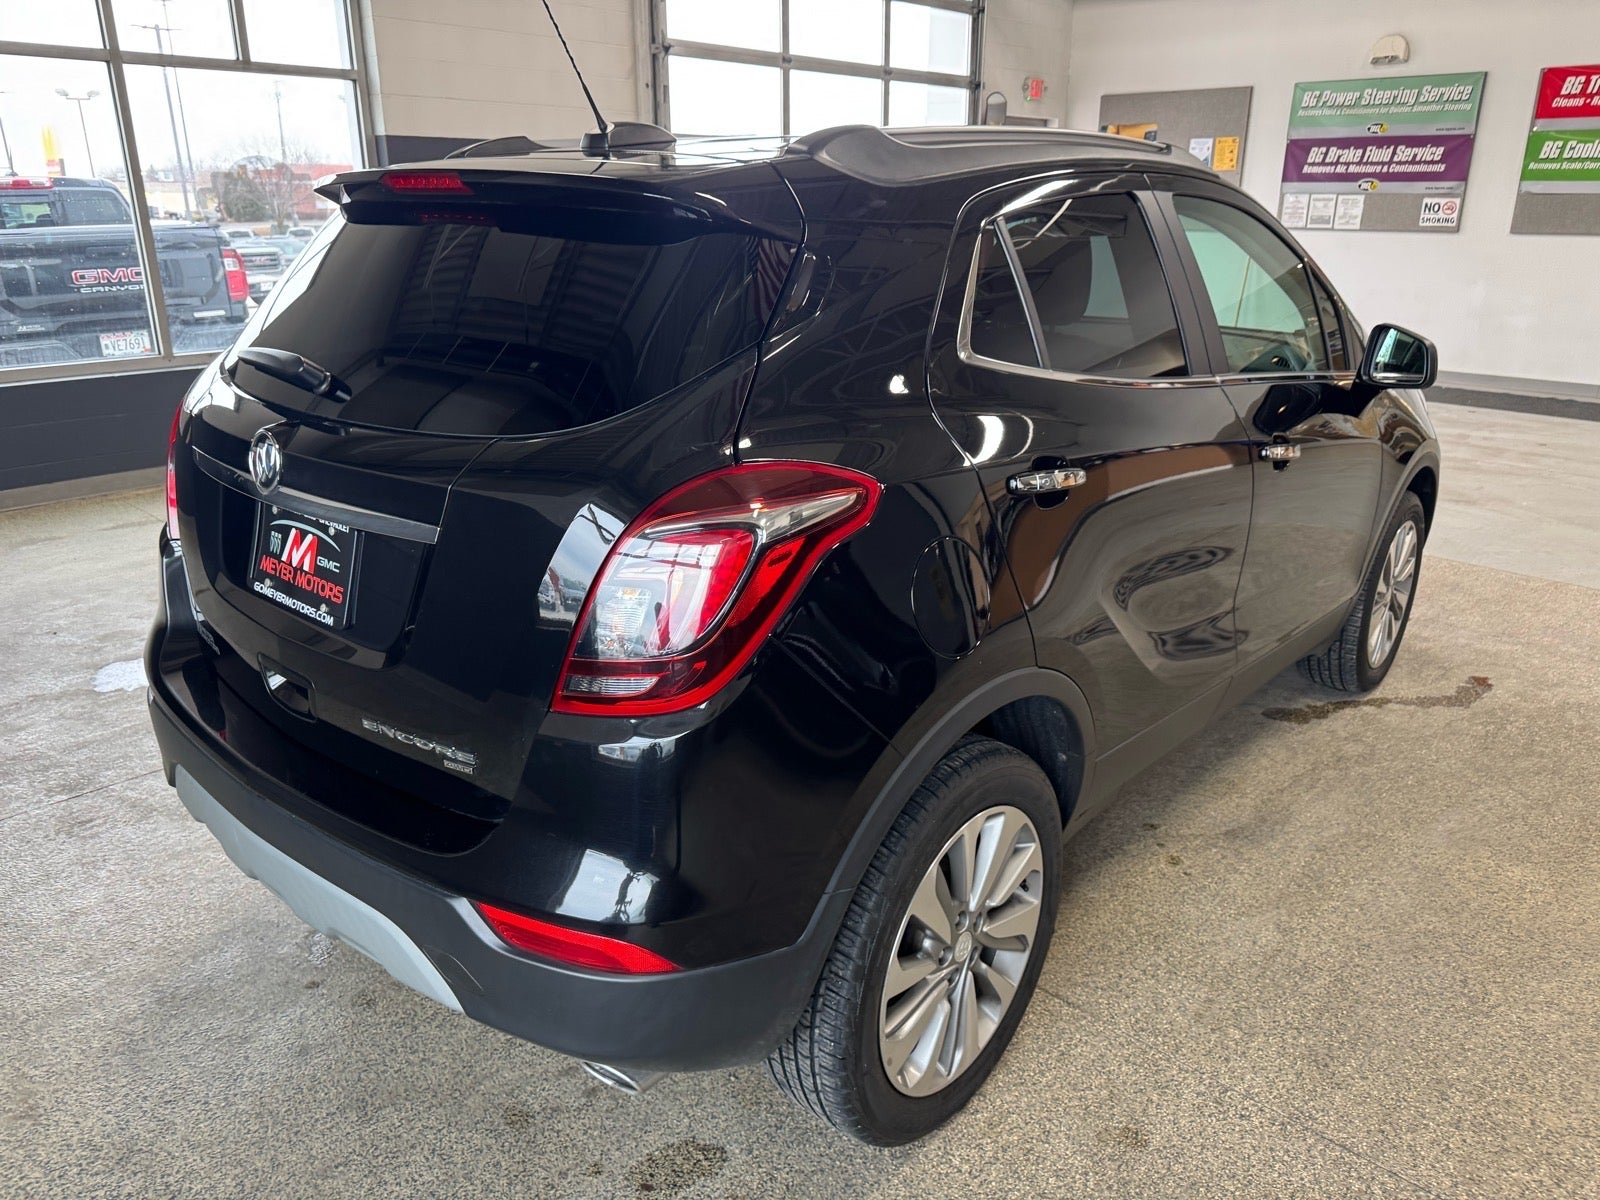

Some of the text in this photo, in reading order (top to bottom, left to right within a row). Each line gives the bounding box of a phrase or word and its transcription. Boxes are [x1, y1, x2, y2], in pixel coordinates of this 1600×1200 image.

[1560, 75, 1586, 95] BG
[1301, 83, 1473, 108] BG Power Steering Service
[1551, 97, 1585, 108] Cleans
[1306, 144, 1444, 163] BG Brake Fluid Service
[1538, 141, 1564, 159] BG
[1302, 164, 1335, 174] Removes
[1347, 164, 1382, 173] Moisture
[1389, 163, 1446, 173] Contaminants
[1528, 162, 1561, 170] Removes
[1423, 202, 1441, 214] NO
[1421, 216, 1455, 224] SMOKING
[80, 284, 144, 293] CANYO
[316, 556, 341, 573] GMC
[260, 555, 345, 604] MEYER MOTORS
[253, 581, 334, 627] GOMEYERMOTORS.COM
[361, 718, 475, 764] ENCORE
